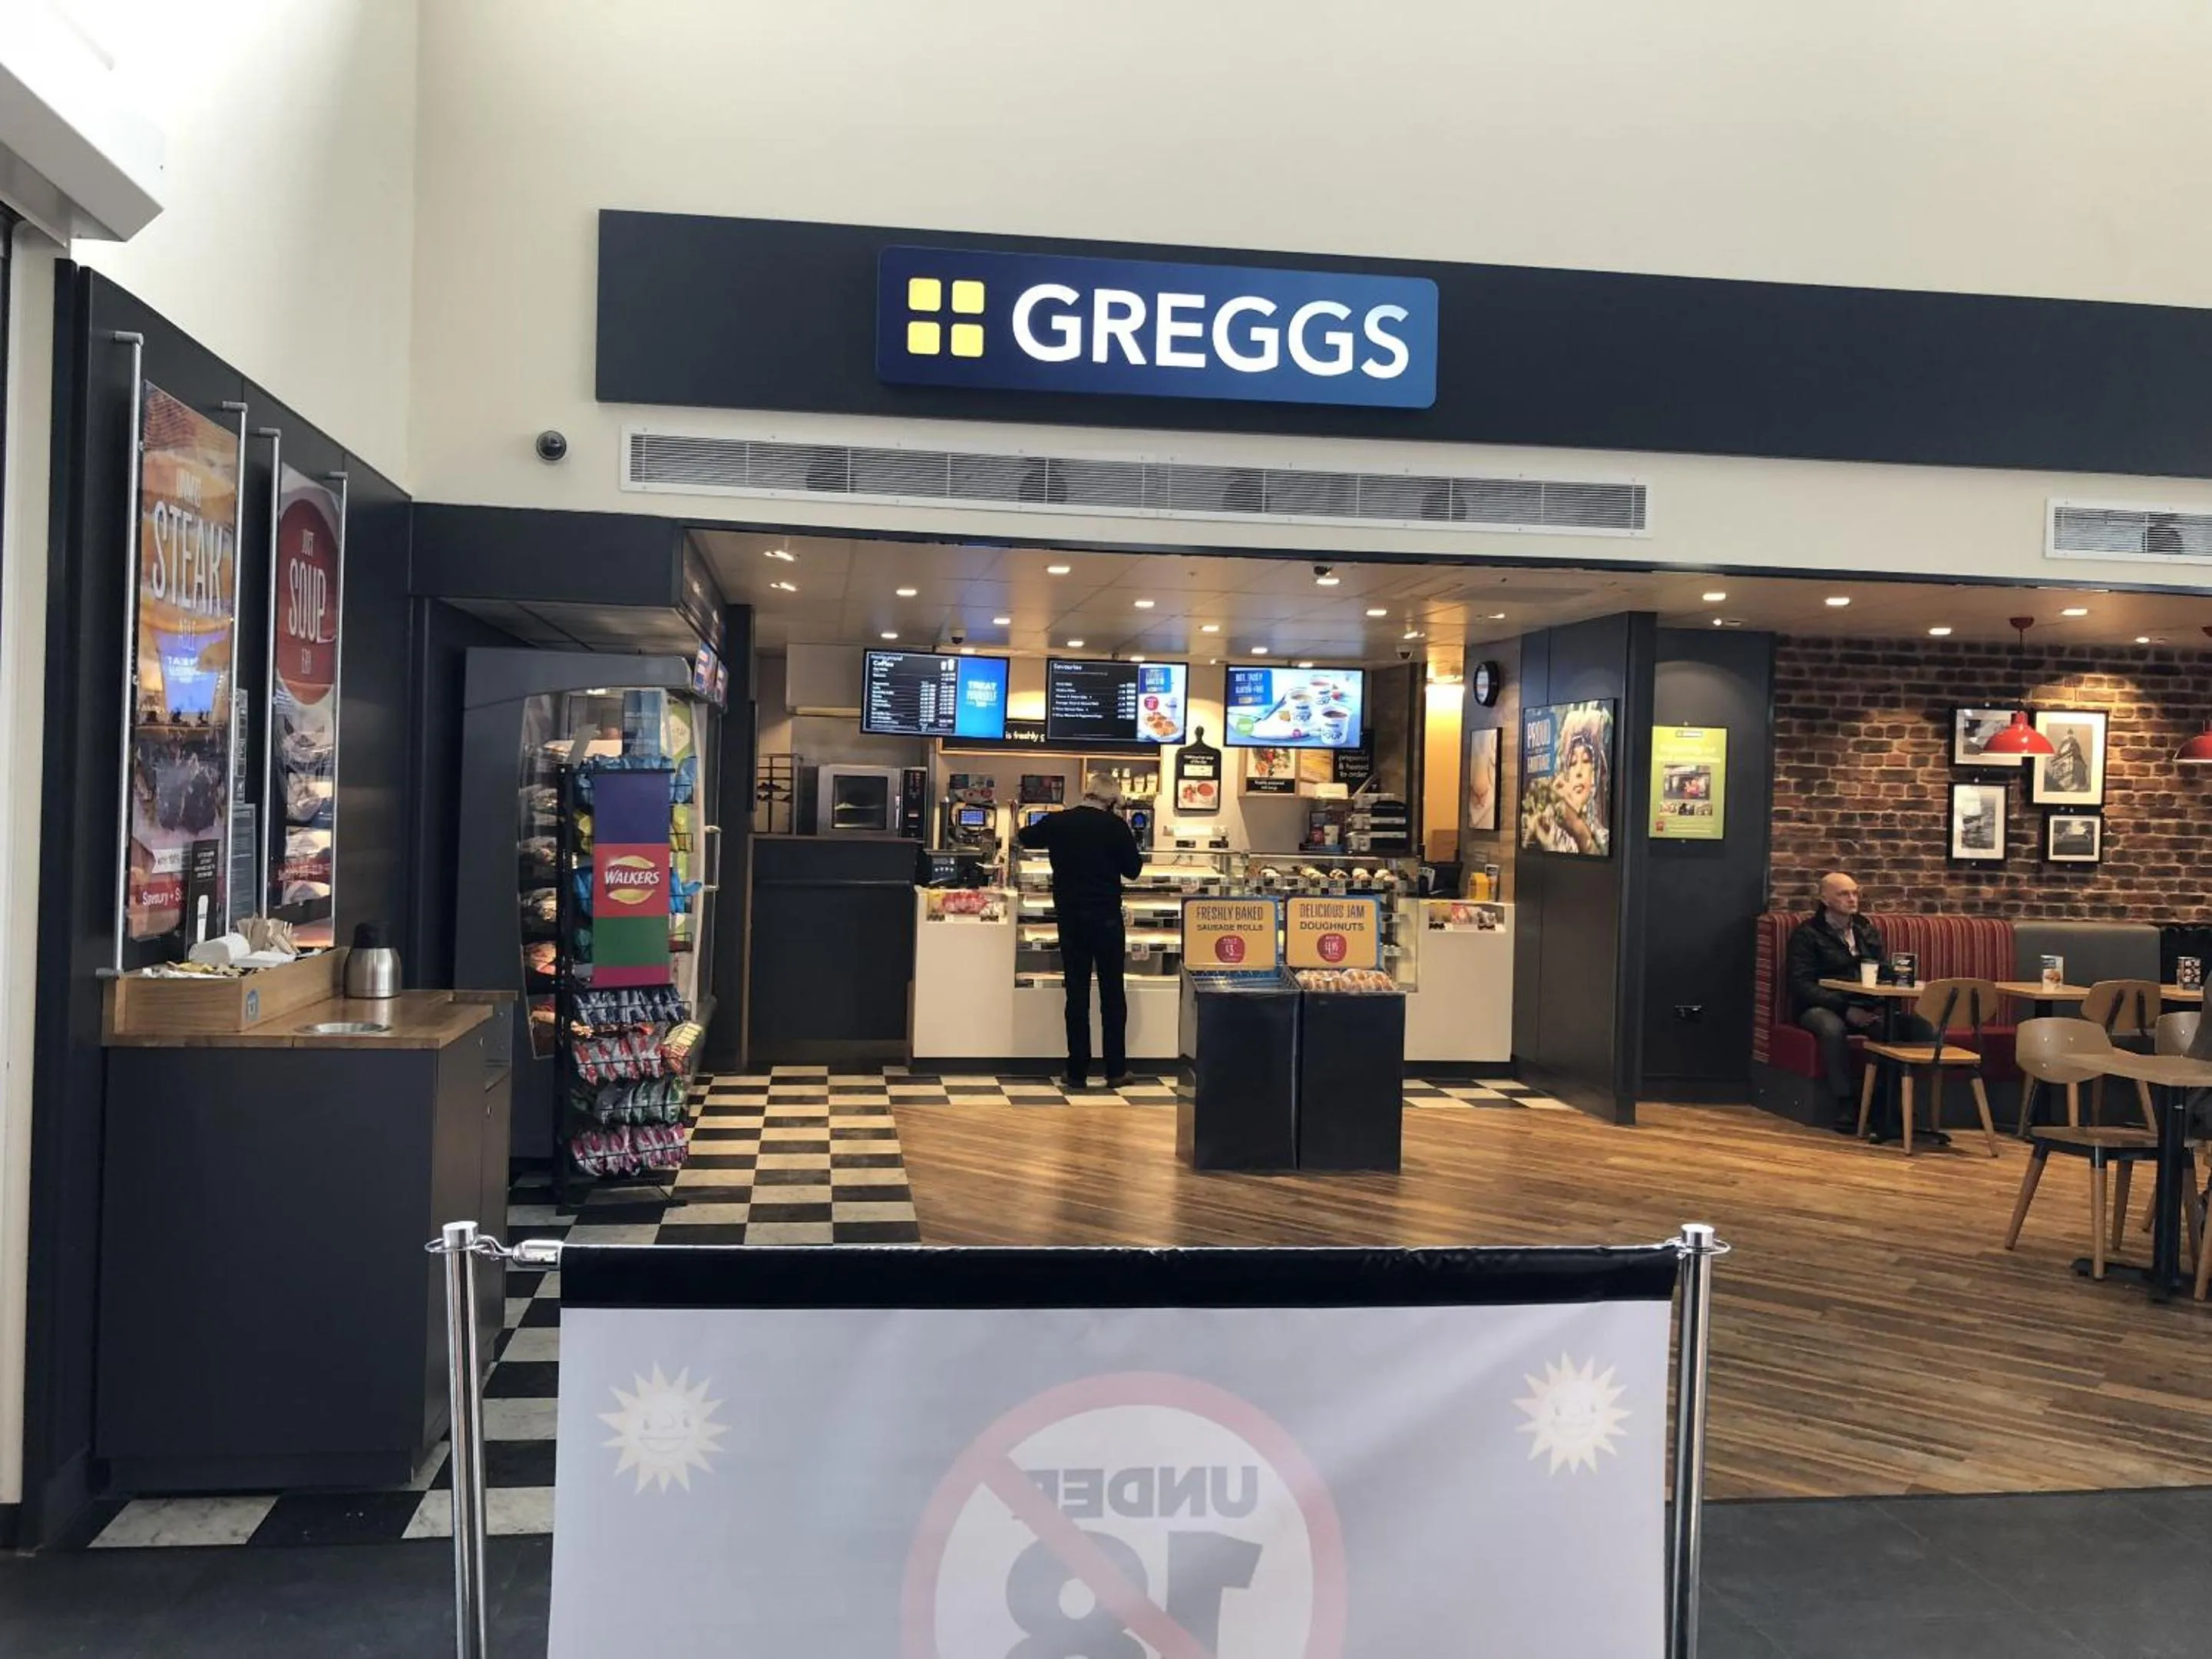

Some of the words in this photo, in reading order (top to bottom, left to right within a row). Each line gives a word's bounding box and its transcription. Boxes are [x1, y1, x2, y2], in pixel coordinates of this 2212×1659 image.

[1012, 283, 1410, 380] GREGGS
[153, 500, 223, 614] STEAK
[289, 557, 336, 643] SOUP
[1005, 731, 1012, 739] is
[605, 869, 660, 885] WALKERS
[1196, 906, 1232, 920] FRESHLY
[1235, 906, 1263, 920] BAKED
[1299, 904, 1344, 918] DELICIOUS
[1346, 904, 1365, 918] JAM
[1300, 922, 1365, 931] DOUGHNUTS
